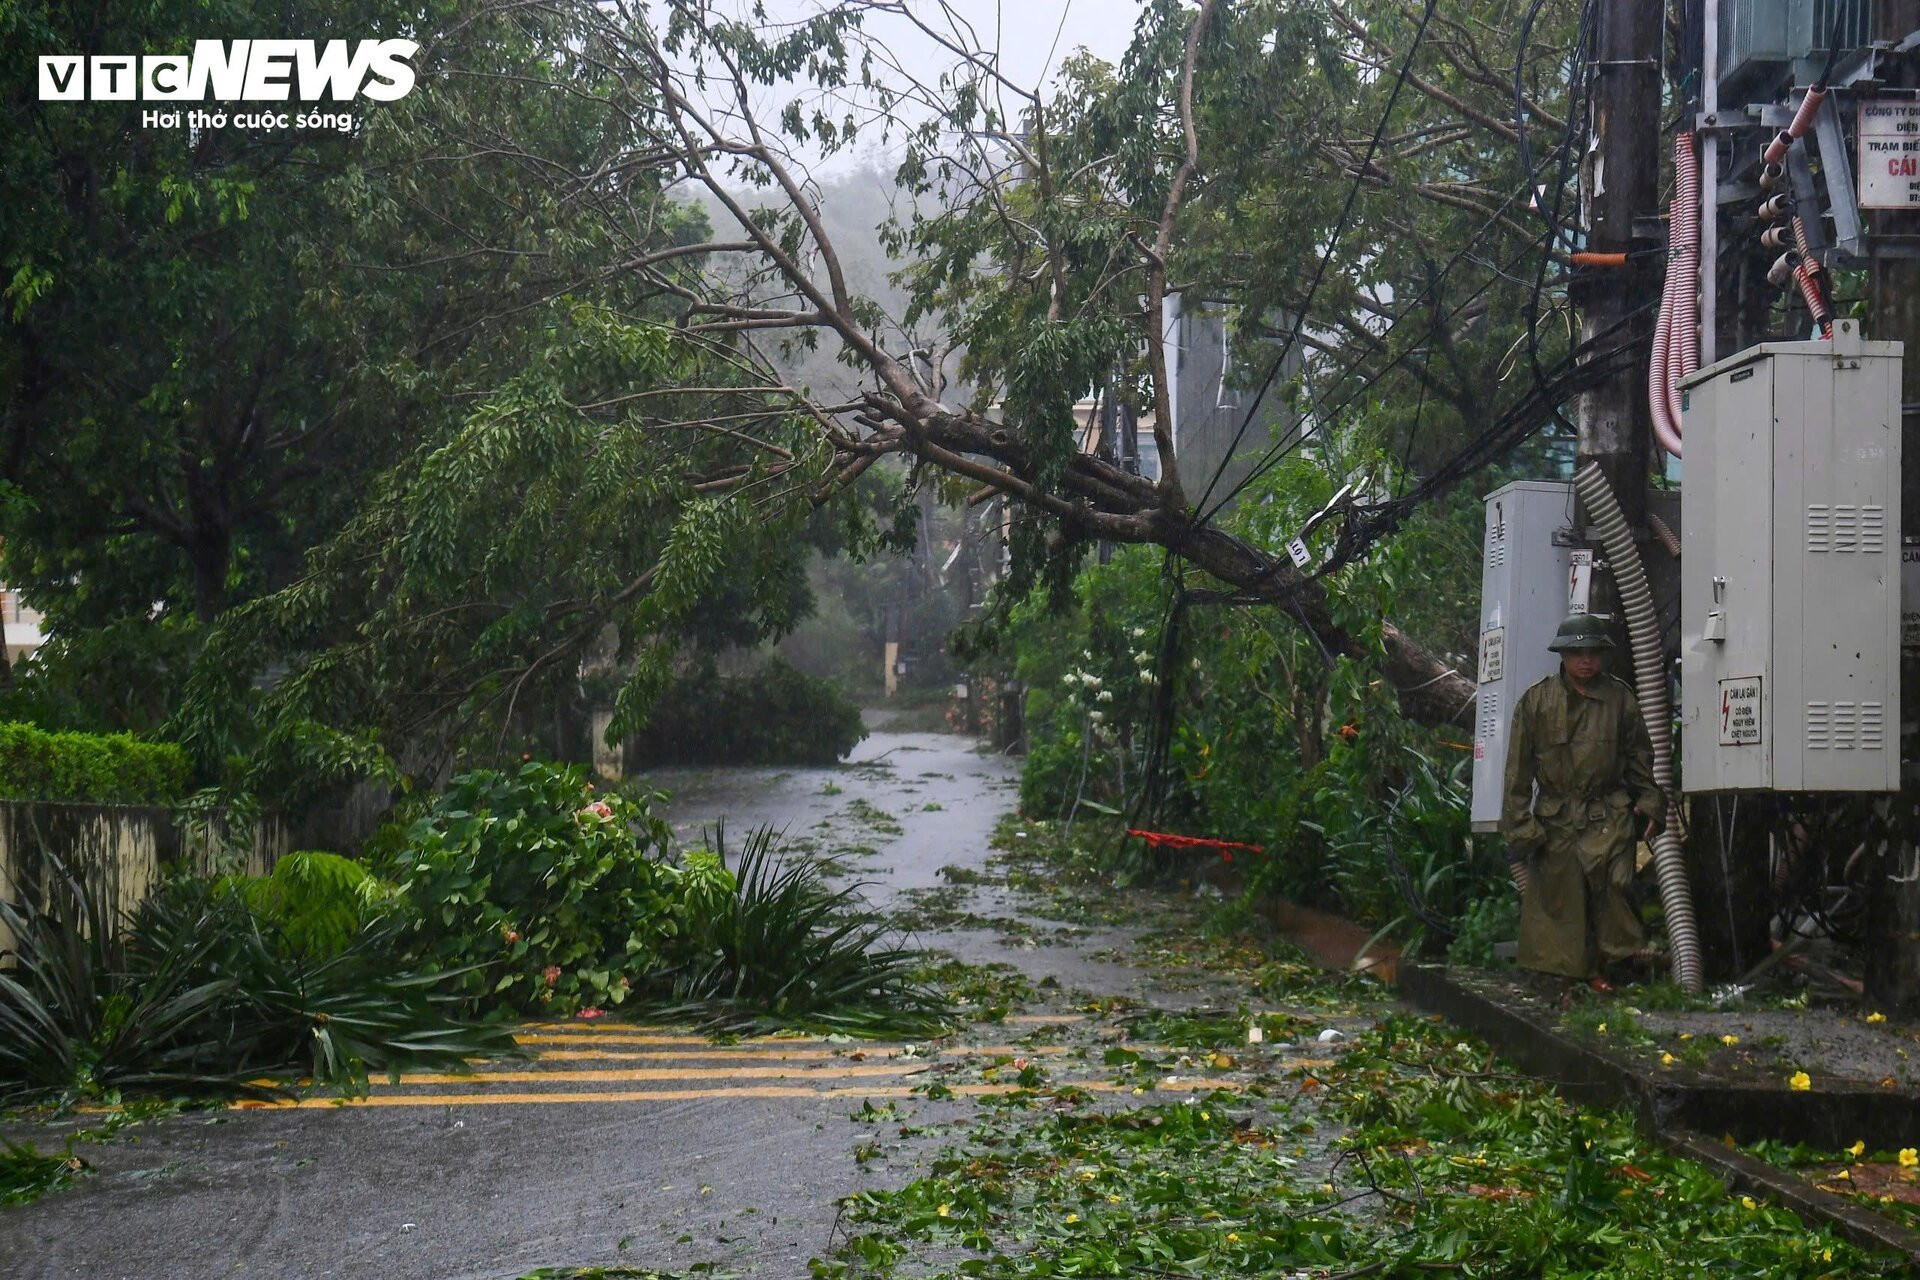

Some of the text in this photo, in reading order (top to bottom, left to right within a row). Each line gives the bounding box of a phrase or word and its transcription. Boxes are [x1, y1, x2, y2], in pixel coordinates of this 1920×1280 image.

[1895, 107, 1906, 116] TY
[1896, 120, 1918, 134] ĐIỆN
[1868, 142, 1899, 153] TRẠM
[1888, 155, 1917, 176] CÁI
